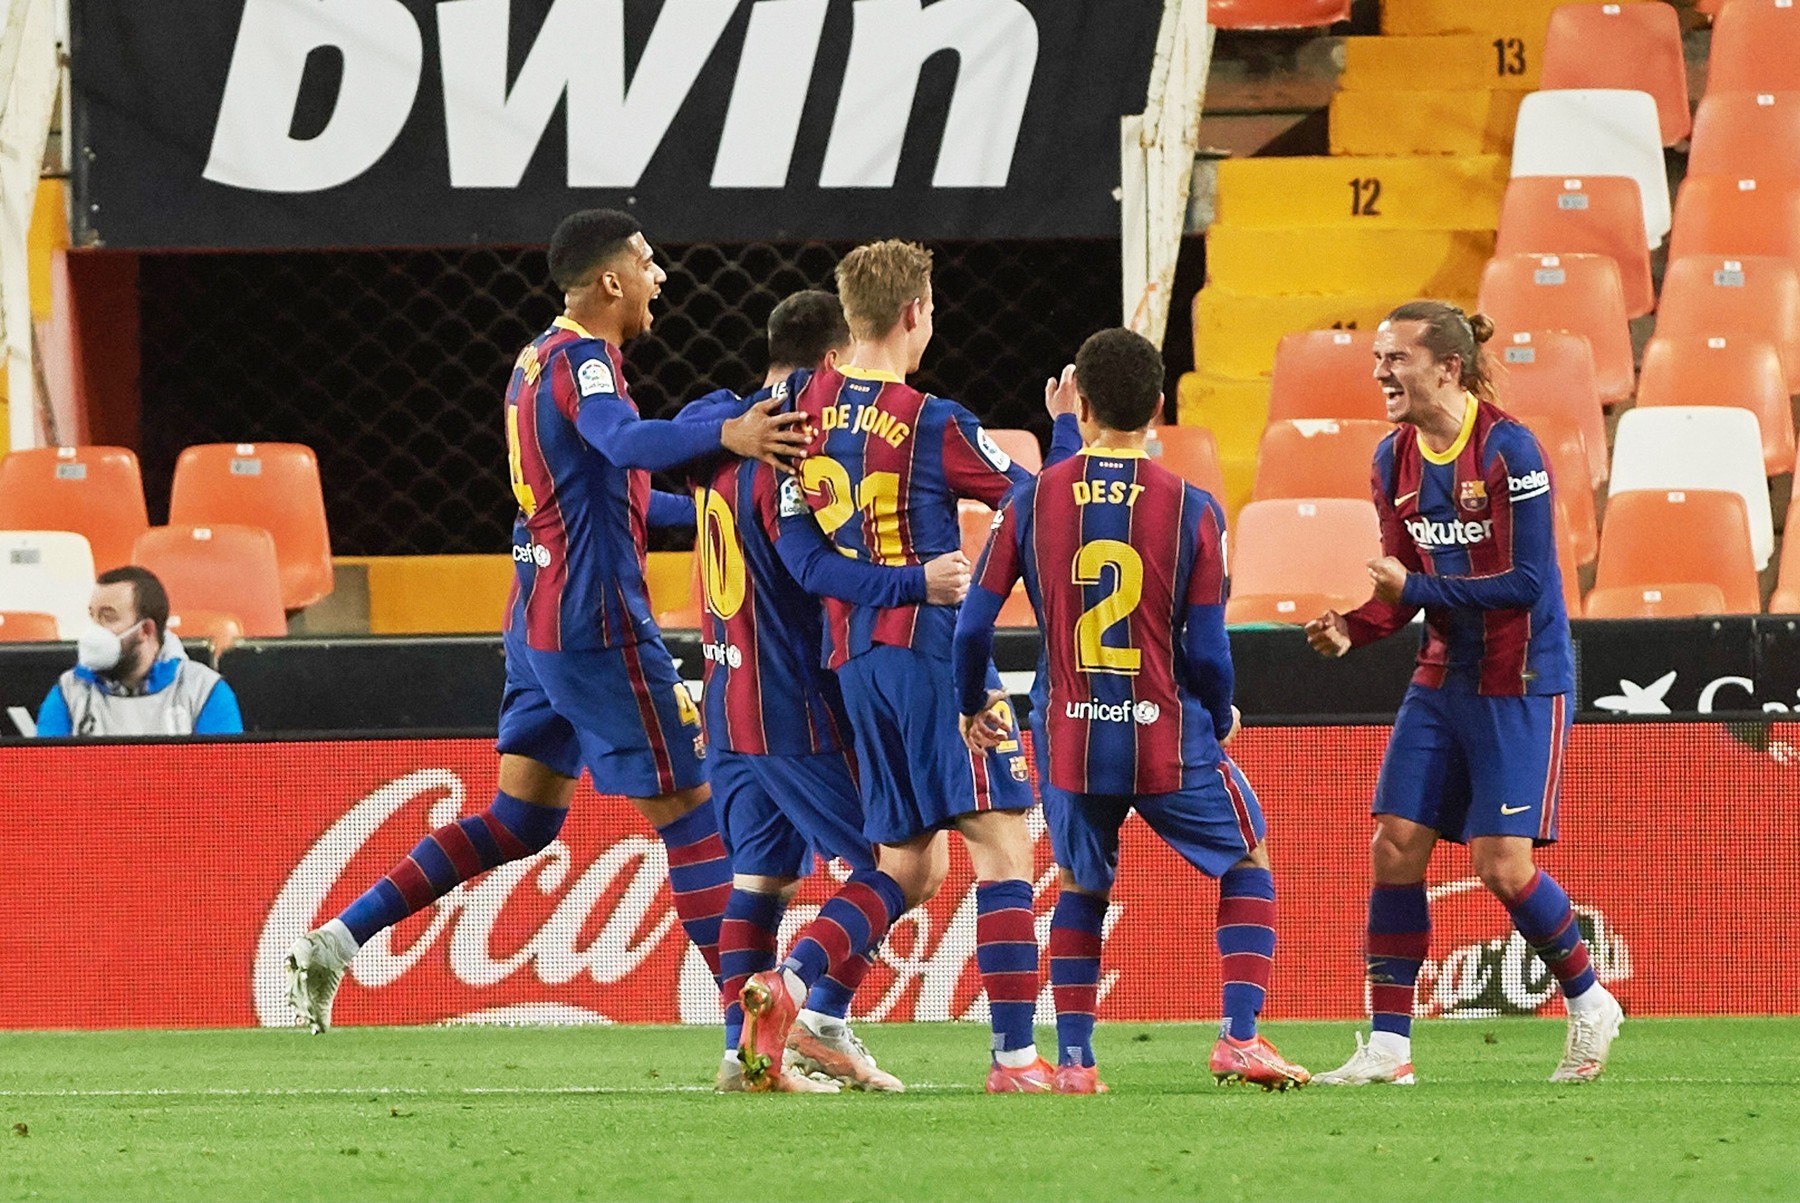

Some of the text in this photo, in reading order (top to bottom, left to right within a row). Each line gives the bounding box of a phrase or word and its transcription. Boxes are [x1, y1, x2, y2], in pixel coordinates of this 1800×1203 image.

[1493, 38, 1527, 76] 13
[1349, 177, 1382, 216] 12
[821, 404, 911, 449] DE JONG
[799, 455, 907, 567] 21
[1072, 480, 1145, 506] DEST
[1072, 539, 1144, 676] 2
[1066, 697, 1134, 723] unicef
